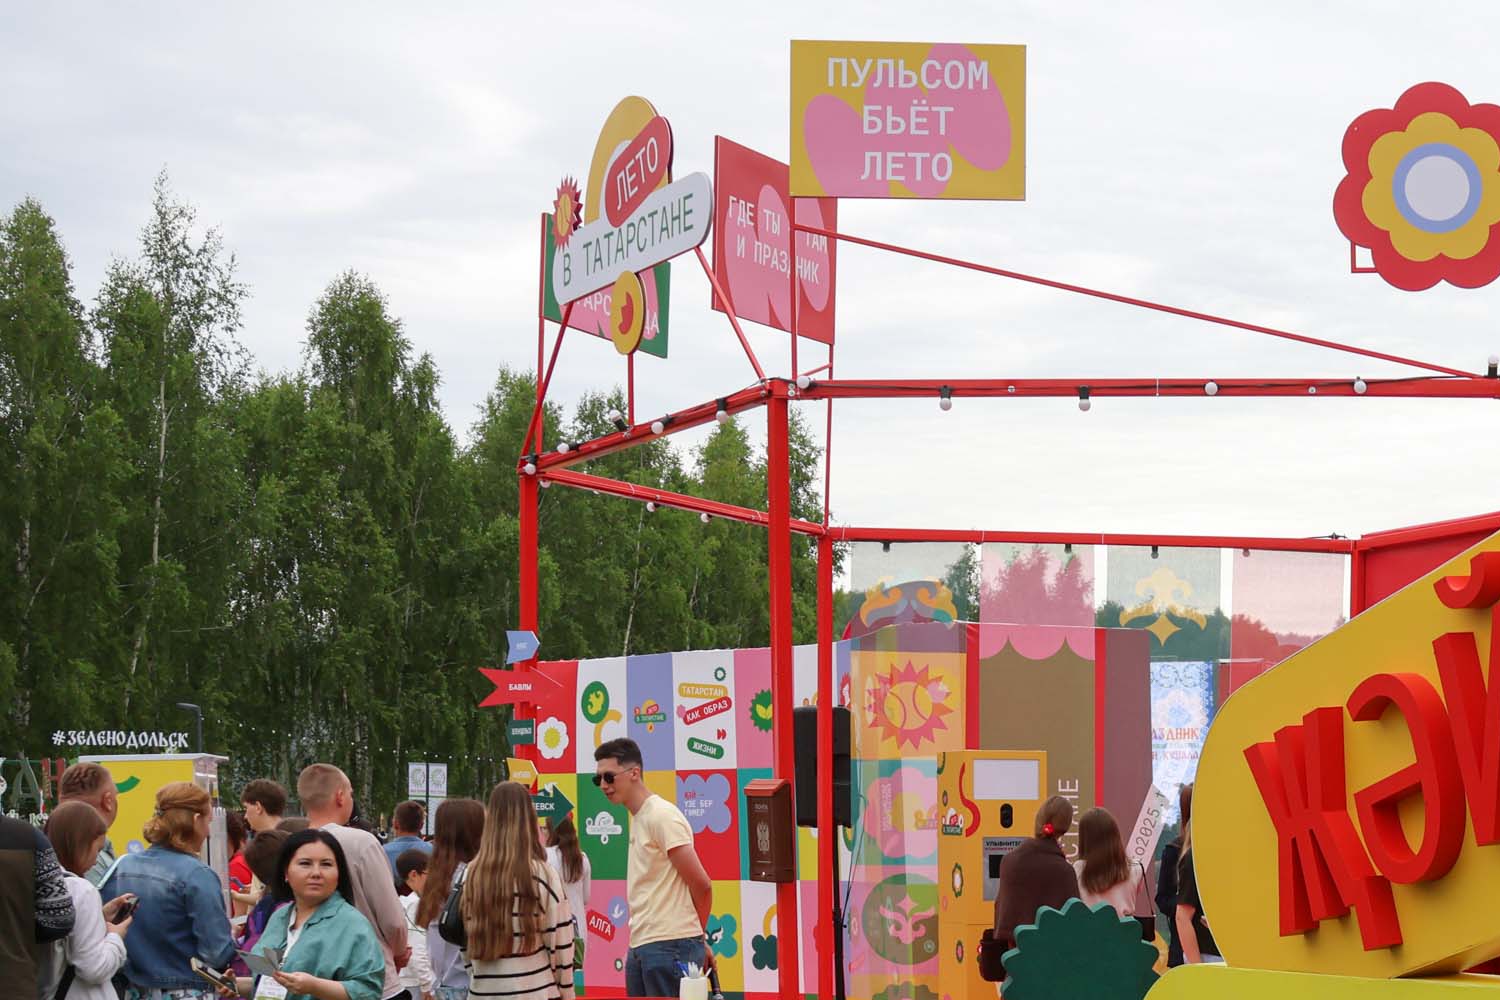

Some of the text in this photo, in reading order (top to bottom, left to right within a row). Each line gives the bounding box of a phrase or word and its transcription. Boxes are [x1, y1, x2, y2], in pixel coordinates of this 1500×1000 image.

[827, 57, 989, 91] ПУЛЬСОМ
[862, 99, 955, 136] БЬЁТ
[616, 136, 659, 212] ЛЕТО
[860, 151, 954, 182] ЛЕТО
[728, 195, 755, 228] ГДЕ
[763, 209, 781, 236] ТЫ
[563, 193, 695, 287] В ТАТАРСТАНЕ
[736, 234, 820, 285] И ПРАЗНИК
[508, 683, 532, 691] БАВЛЫ
[682, 686, 724, 697] ТАТАРСТАН
[686, 700, 728, 722] КАК ОБРАЗ
[51, 730, 189, 749] #ЗЕЛЕНОДОЛЬСК
[1152, 727, 1200, 741] АЗДНИК
[693, 741, 718, 755] ЖИЗНИ
[589, 915, 612, 937] АЛГА
